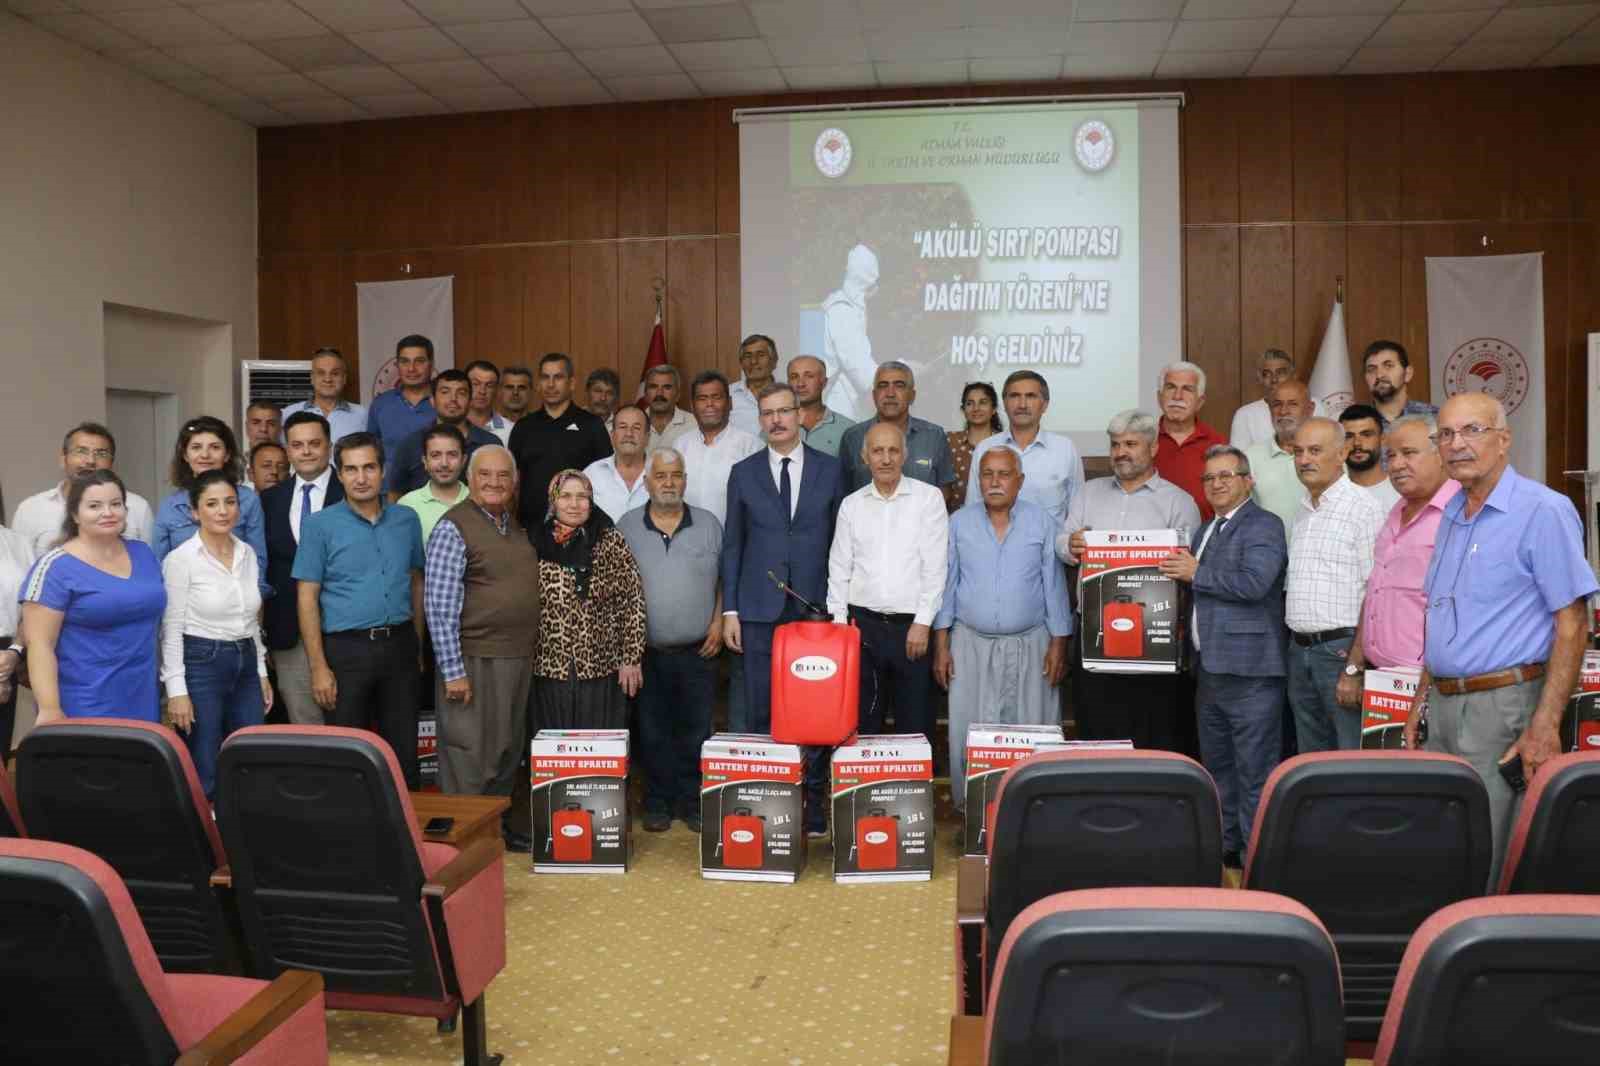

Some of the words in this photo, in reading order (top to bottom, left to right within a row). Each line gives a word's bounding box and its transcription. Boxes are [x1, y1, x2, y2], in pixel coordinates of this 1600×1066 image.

[987, 228, 1031, 257] SIRT
[1033, 227, 1120, 256] POMPASI
[924, 274, 1000, 311] DAĞITIM
[951, 335, 990, 371] HOŞ
[994, 326, 1082, 364] GELDİNİZ
[1088, 551, 1127, 559] BATTERY
[1129, 551, 1169, 559] SPRAYE
[972, 751, 1011, 760] BATTERY
[536, 760, 575, 768] BATTERY
[578, 760, 618, 768] SPRAYER
[708, 762, 748, 772] BATTERY
[750, 764, 791, 774] SPRAYER
[840, 765, 880, 773] BATTERY
[883, 764, 925, 773] SPRAYER
